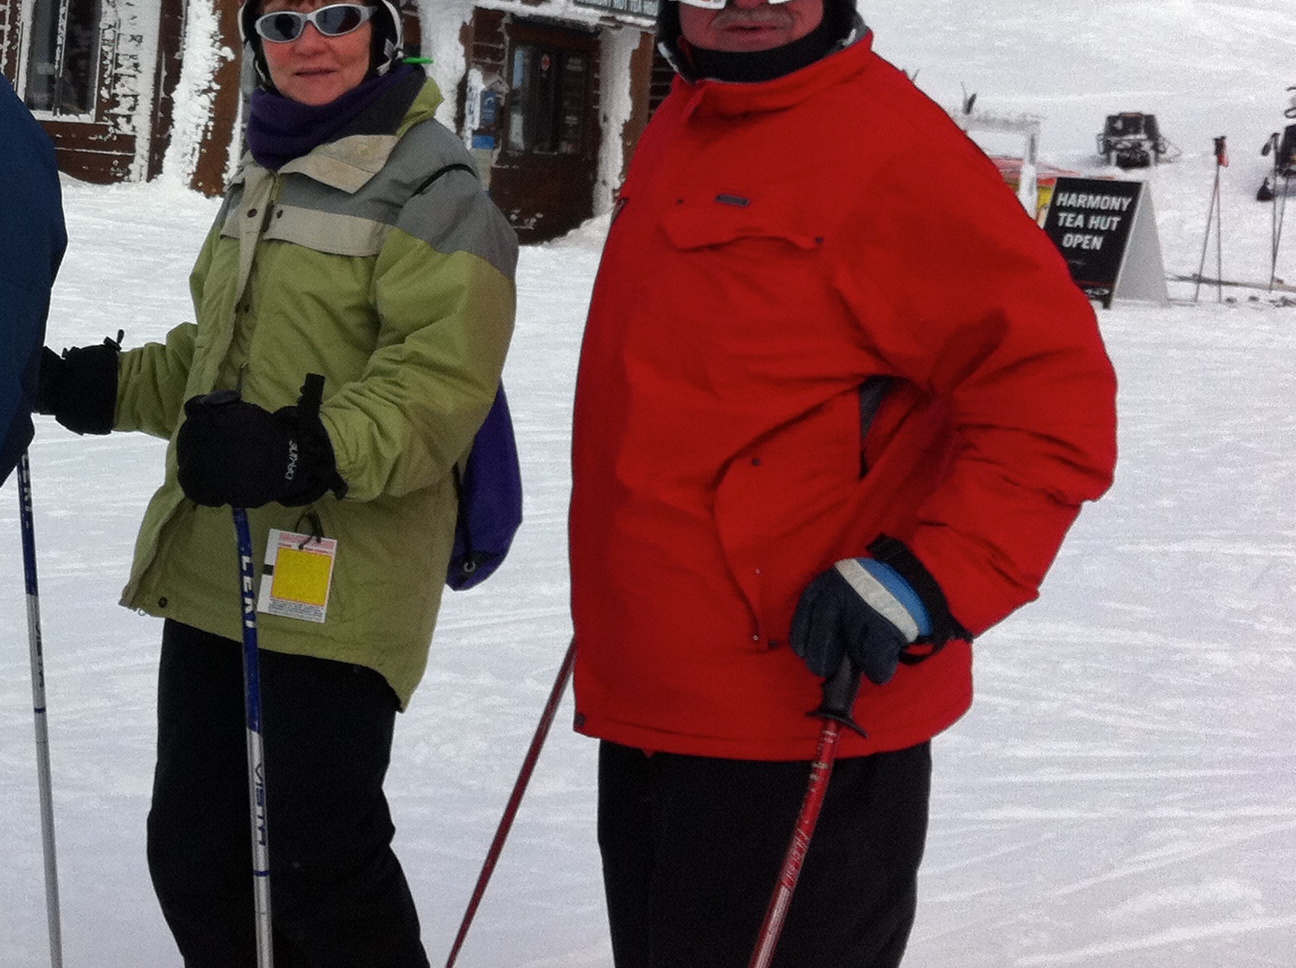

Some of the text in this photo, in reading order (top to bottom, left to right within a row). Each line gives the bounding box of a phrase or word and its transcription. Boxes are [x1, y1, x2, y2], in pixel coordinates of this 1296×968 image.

[1056, 193, 1132, 212] HARMONY
[1058, 212, 1122, 231] TEA HUT
[1062, 233, 1104, 251] OPEN
